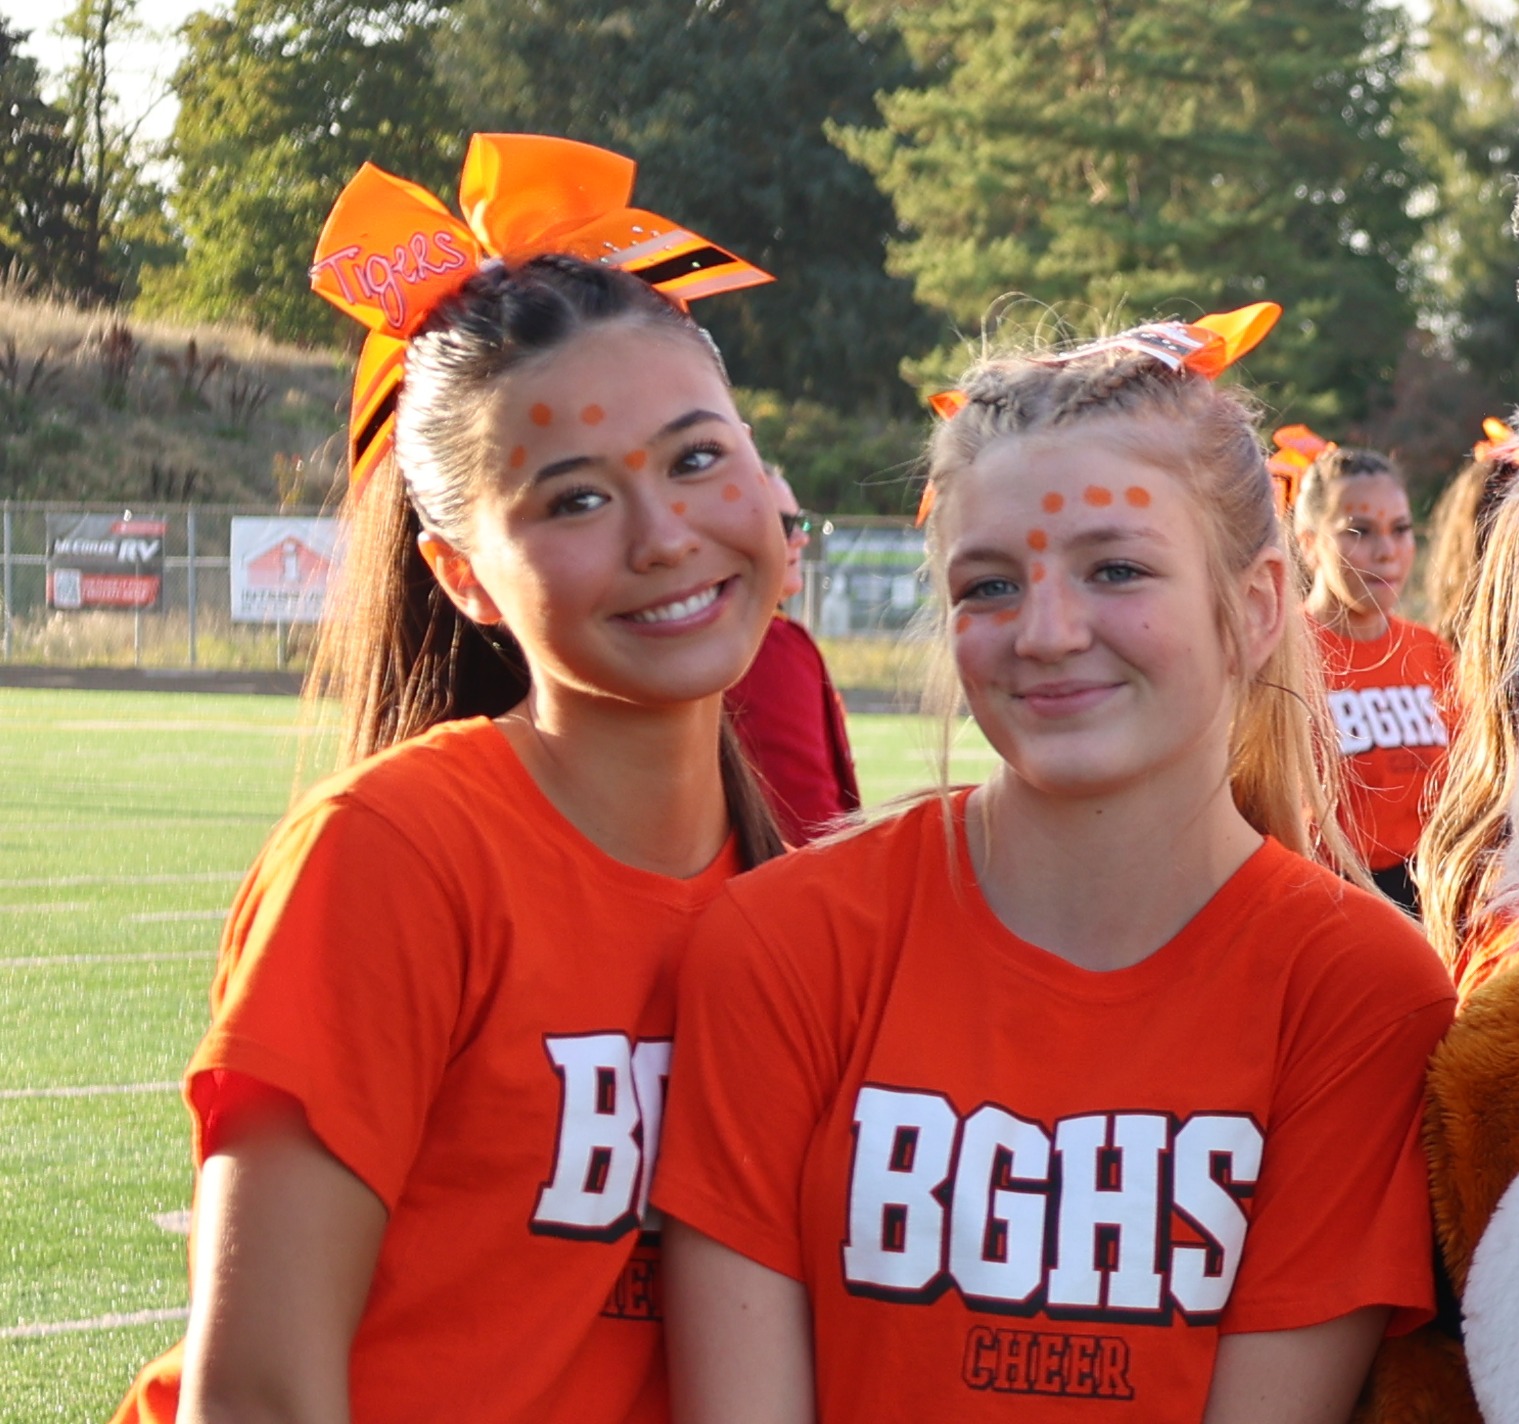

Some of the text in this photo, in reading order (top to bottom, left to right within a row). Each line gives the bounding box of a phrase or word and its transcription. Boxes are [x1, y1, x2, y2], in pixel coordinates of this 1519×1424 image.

[118, 538, 160, 563] RV
[839, 1081, 1265, 1327] BGHS
[961, 1325, 1135, 1401] CHEER
